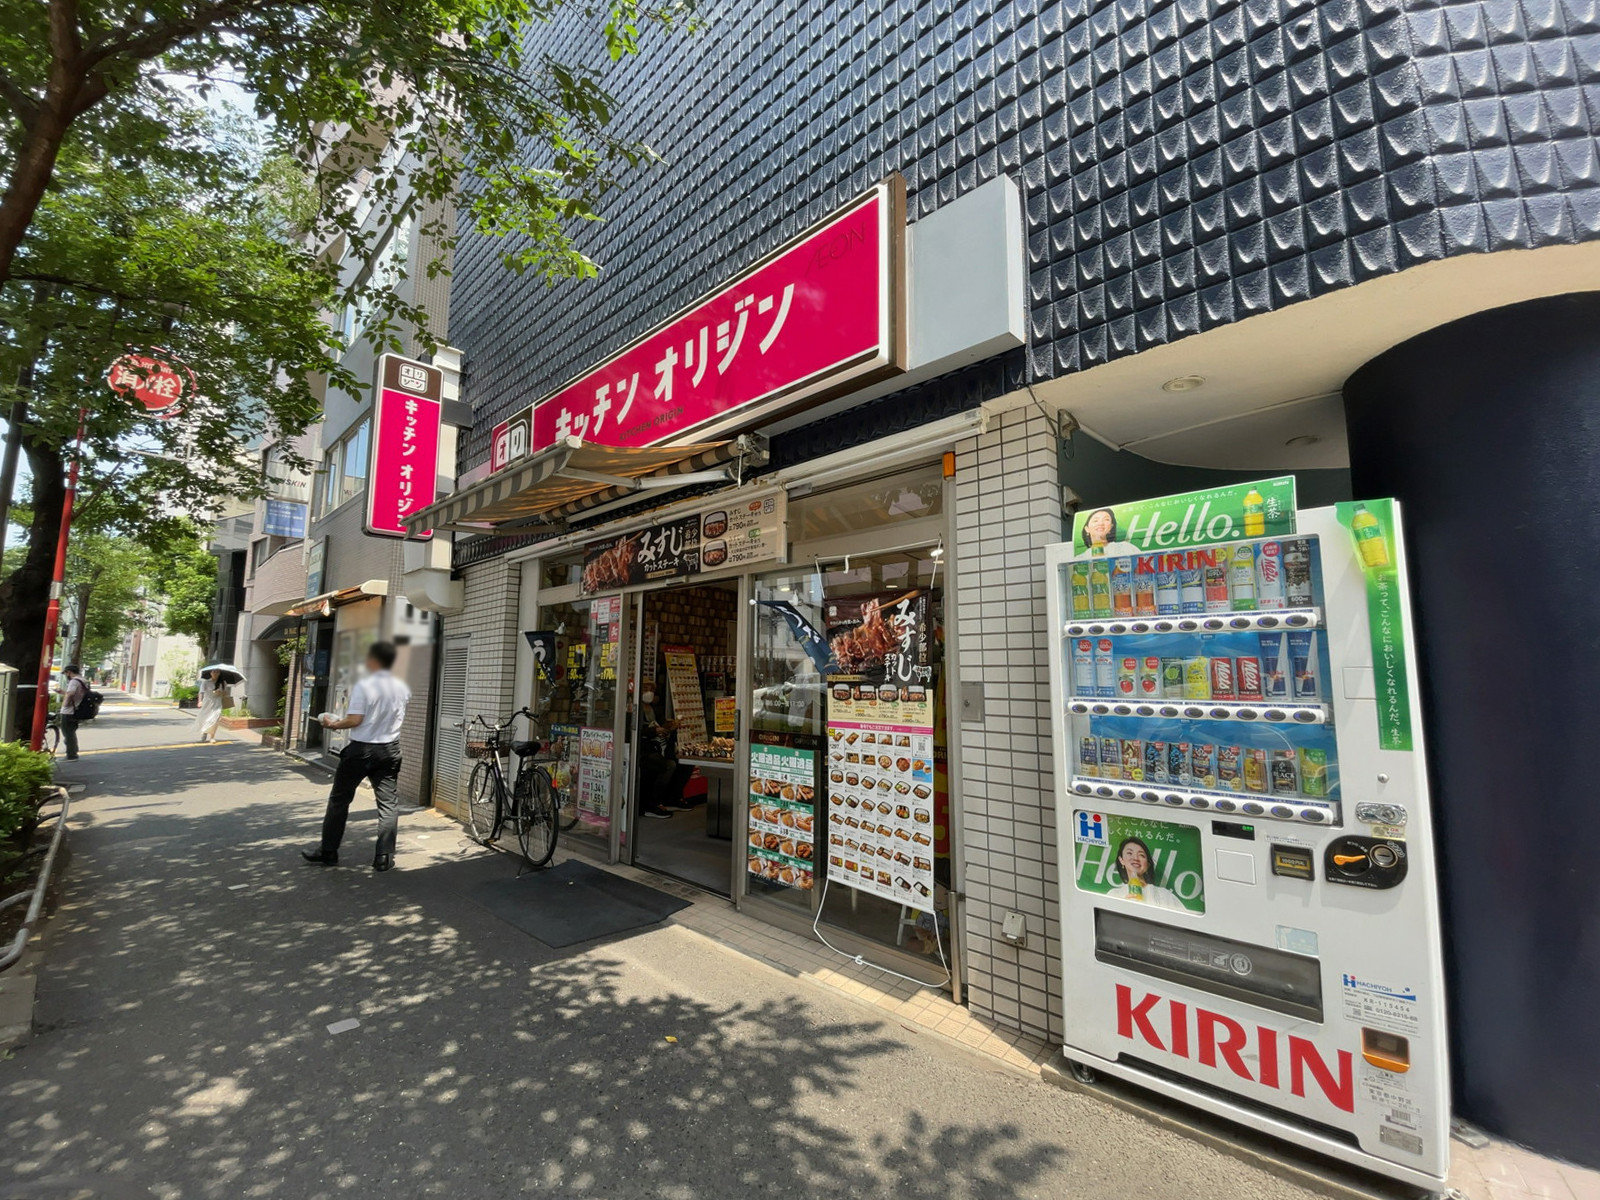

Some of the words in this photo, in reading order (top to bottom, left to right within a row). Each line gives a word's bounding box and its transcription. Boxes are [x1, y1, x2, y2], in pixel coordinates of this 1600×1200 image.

[554, 373, 639, 442] キッチン
[654, 283, 794, 402] オリジン
[403, 400, 418, 456] キッチン
[619, 422, 651, 441] KITCHEN
[653, 406, 684, 426] ORIGIN
[1267, 497, 1281, 519] 生茶
[1126, 502, 1241, 548] Hello.
[638, 526, 683, 563] みすじ
[644, 557, 679, 572] カットステーキ
[1137, 549, 1217, 575] KIRIN
[894, 598, 917, 682] みすじ
[1218, 661, 1232, 690] Mets
[1244, 660, 1259, 690] Mets
[1077, 836, 1107, 846] HACHIYOH
[1357, 981, 1392, 992] HACHIYOH
[1115, 983, 1355, 1114] KIRIN
